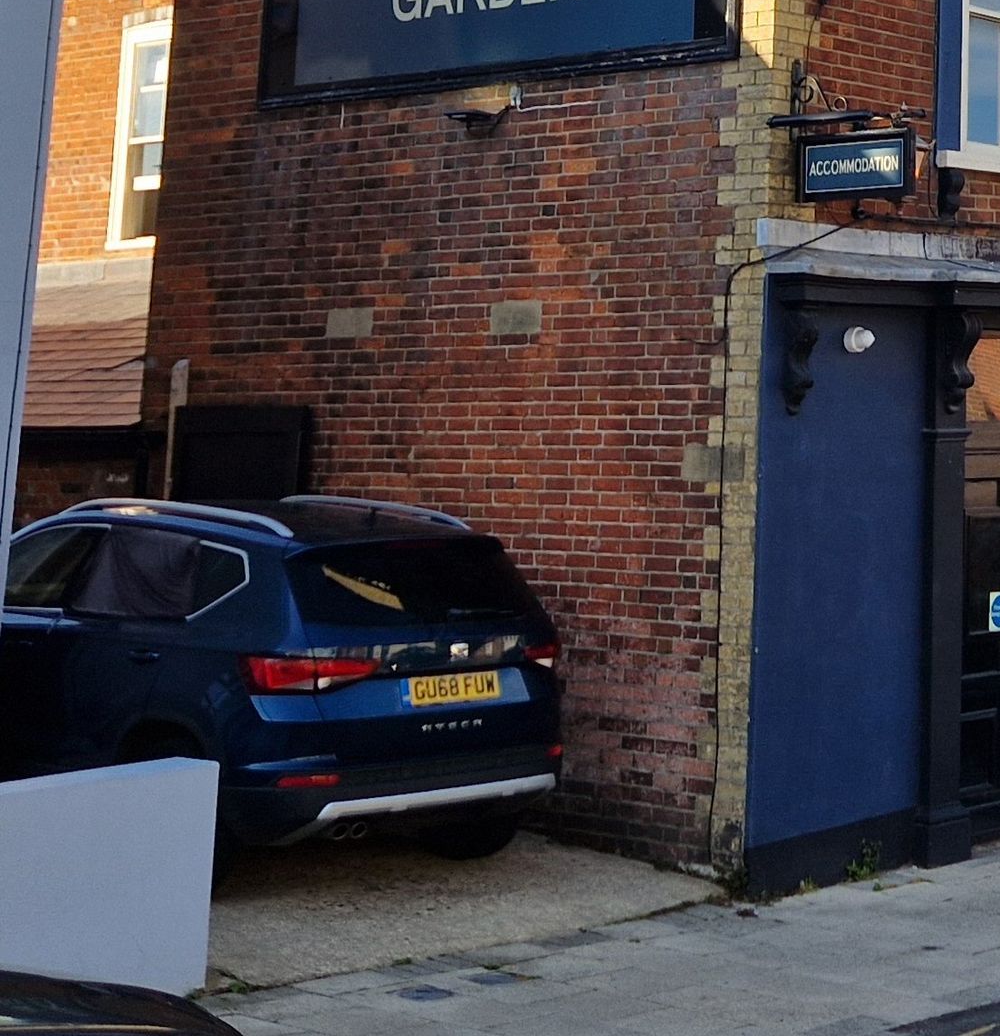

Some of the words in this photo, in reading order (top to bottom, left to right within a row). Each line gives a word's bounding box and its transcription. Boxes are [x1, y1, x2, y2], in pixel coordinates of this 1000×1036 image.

[808, 155, 899, 177] ACCOMMODATION
[414, 677, 459, 700] GU68
[463, 672, 495, 696] FUW
